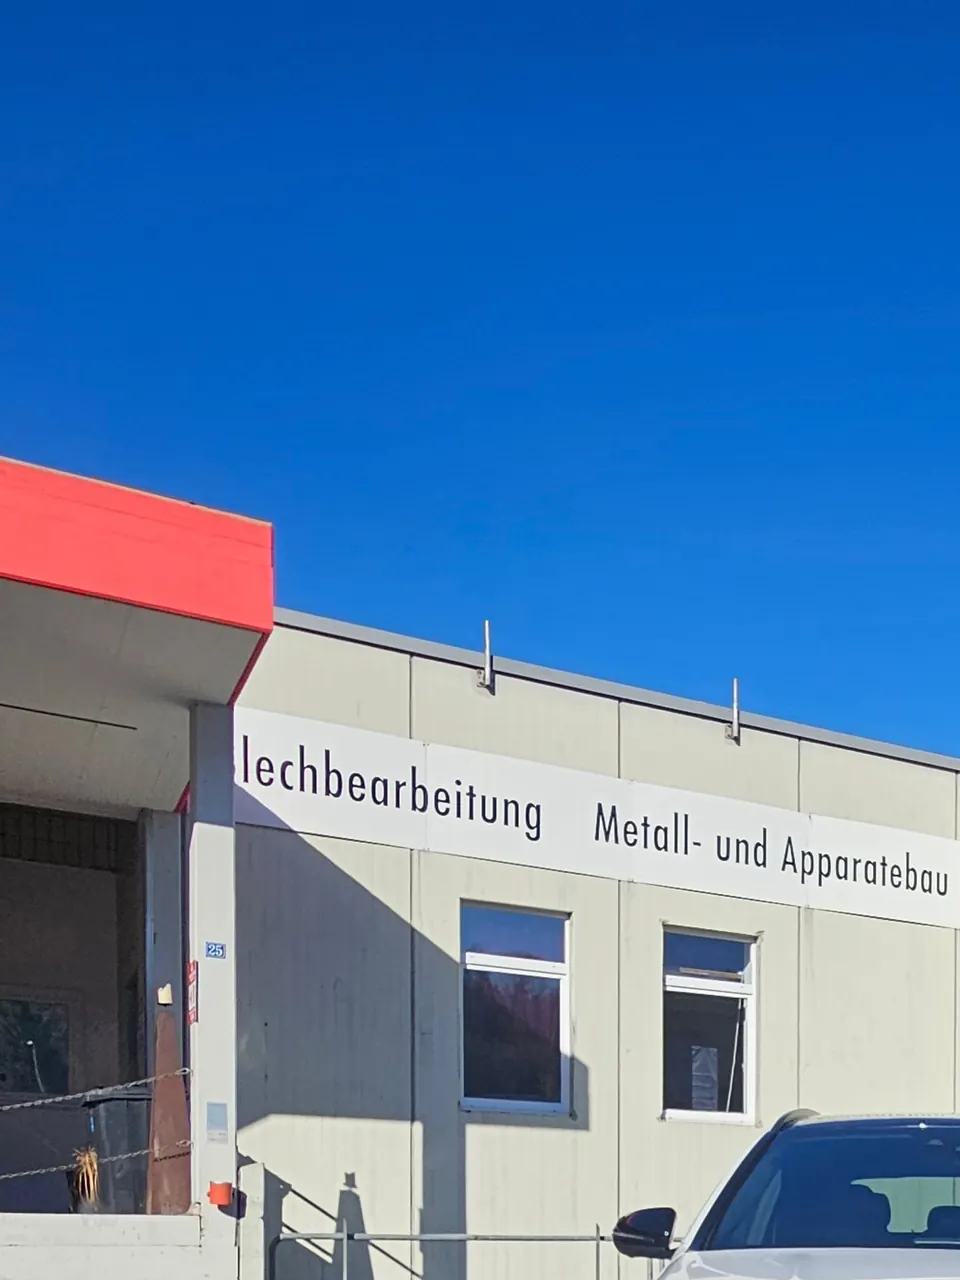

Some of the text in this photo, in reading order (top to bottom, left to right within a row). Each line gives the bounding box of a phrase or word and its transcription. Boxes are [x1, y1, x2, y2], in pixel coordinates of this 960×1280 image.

[242, 735, 541, 842] lechbearbeitung
[594, 802, 949, 896] Metall- und Apparatebau
[208, 944, 222, 957] 25
